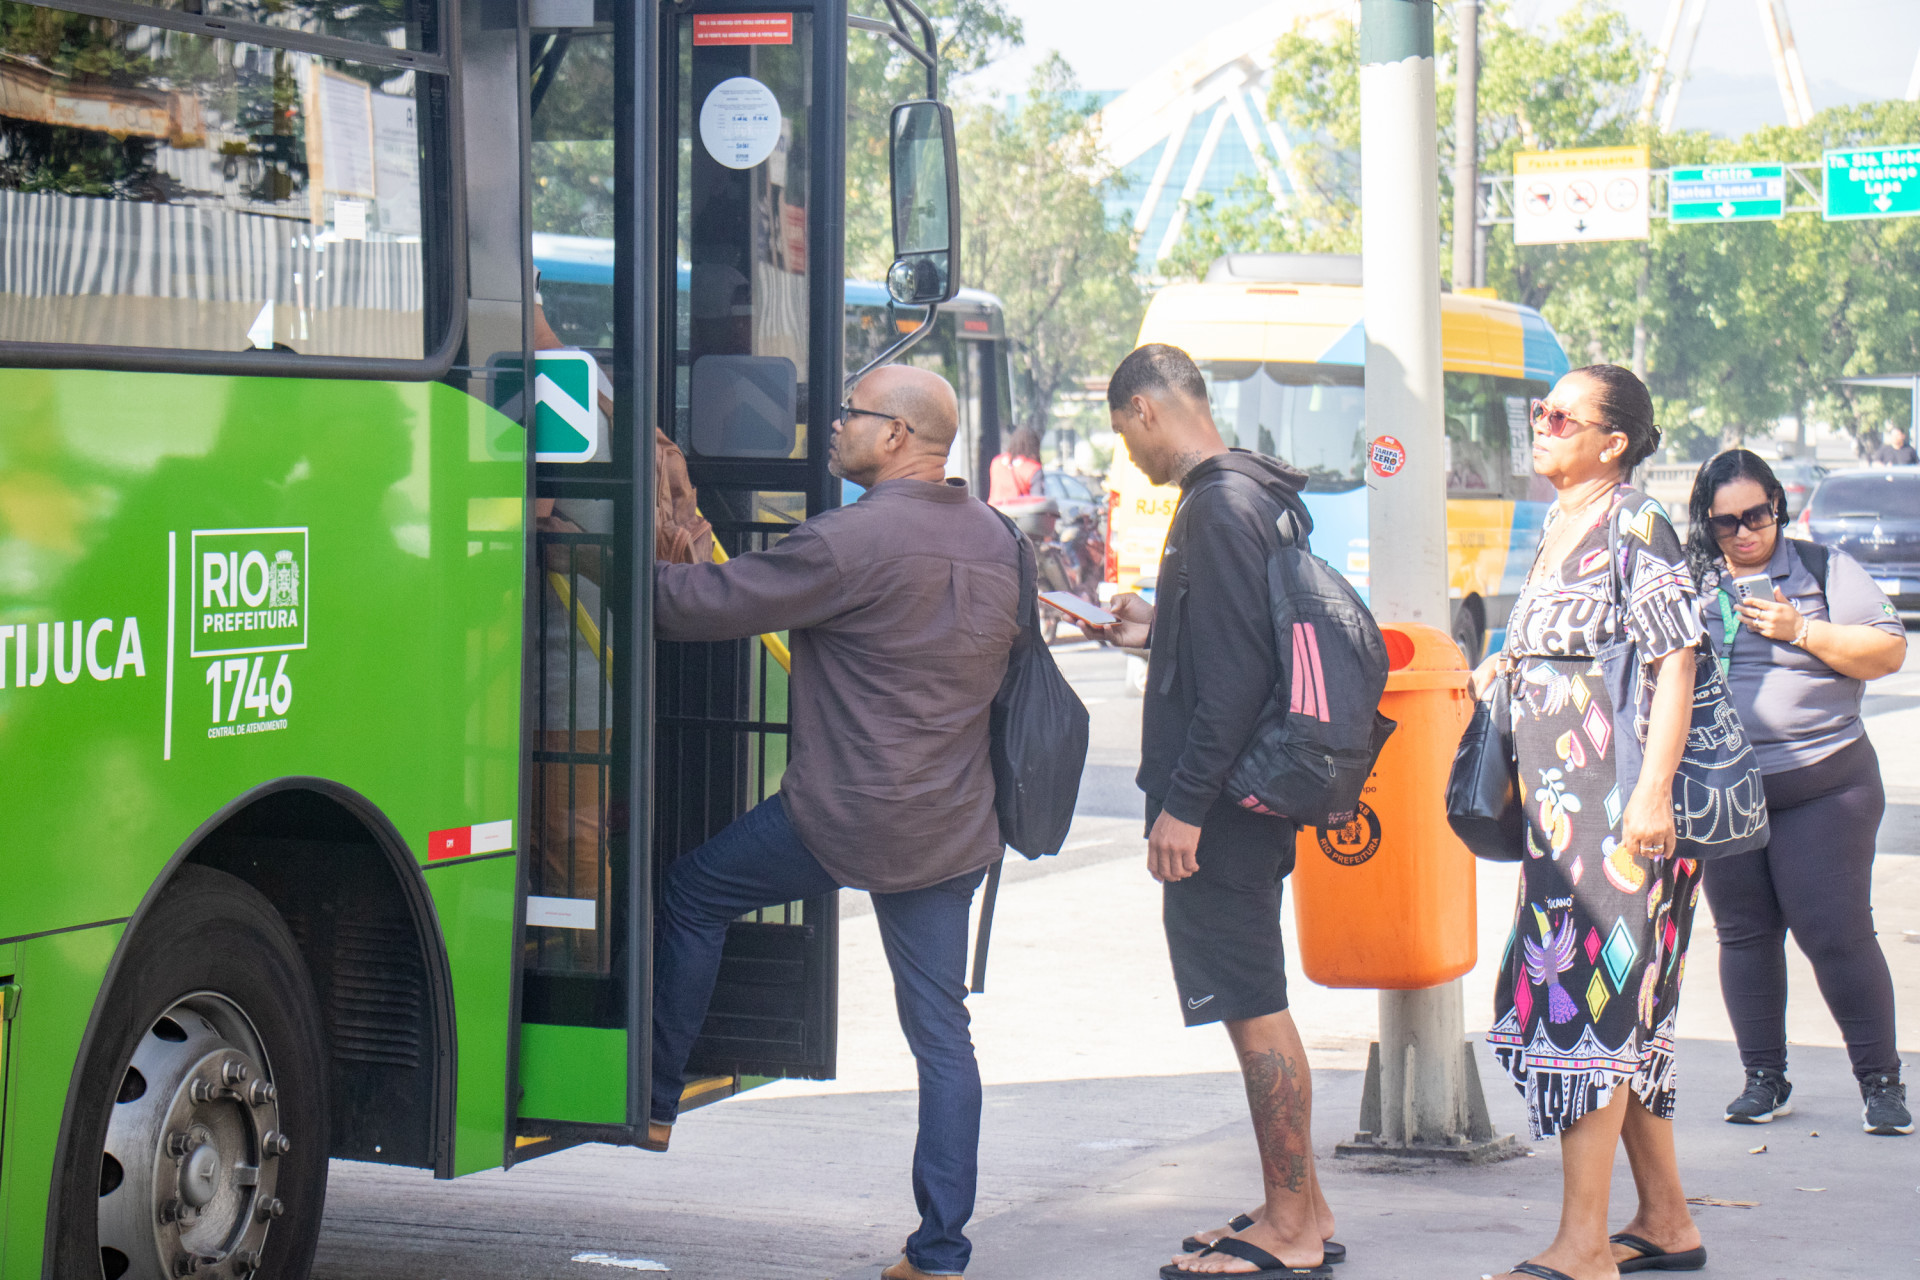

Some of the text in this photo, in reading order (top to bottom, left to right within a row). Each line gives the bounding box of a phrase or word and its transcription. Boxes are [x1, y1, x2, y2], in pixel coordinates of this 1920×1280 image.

[1702, 168, 1753, 180] Centro
[1849, 166, 1918, 181] Botafogo
[1671, 182, 1764, 199] Santos Dumont
[1864, 181, 1902, 195] Lapa
[1374, 446, 1398, 459] TARIFA
[1374, 453, 1397, 466] ZERO
[1136, 499, 1178, 516] RJ-5
[203, 550, 270, 607] RIO
[203, 609, 298, 633] PREFEITURA
[206, 654, 292, 723] 1746
[1692, 689, 1710, 701] HOP
[208, 719, 288, 738] CENTRAL DE ATENDIMENTO
[1320, 838, 1379, 864] RIO PREFEITURA
